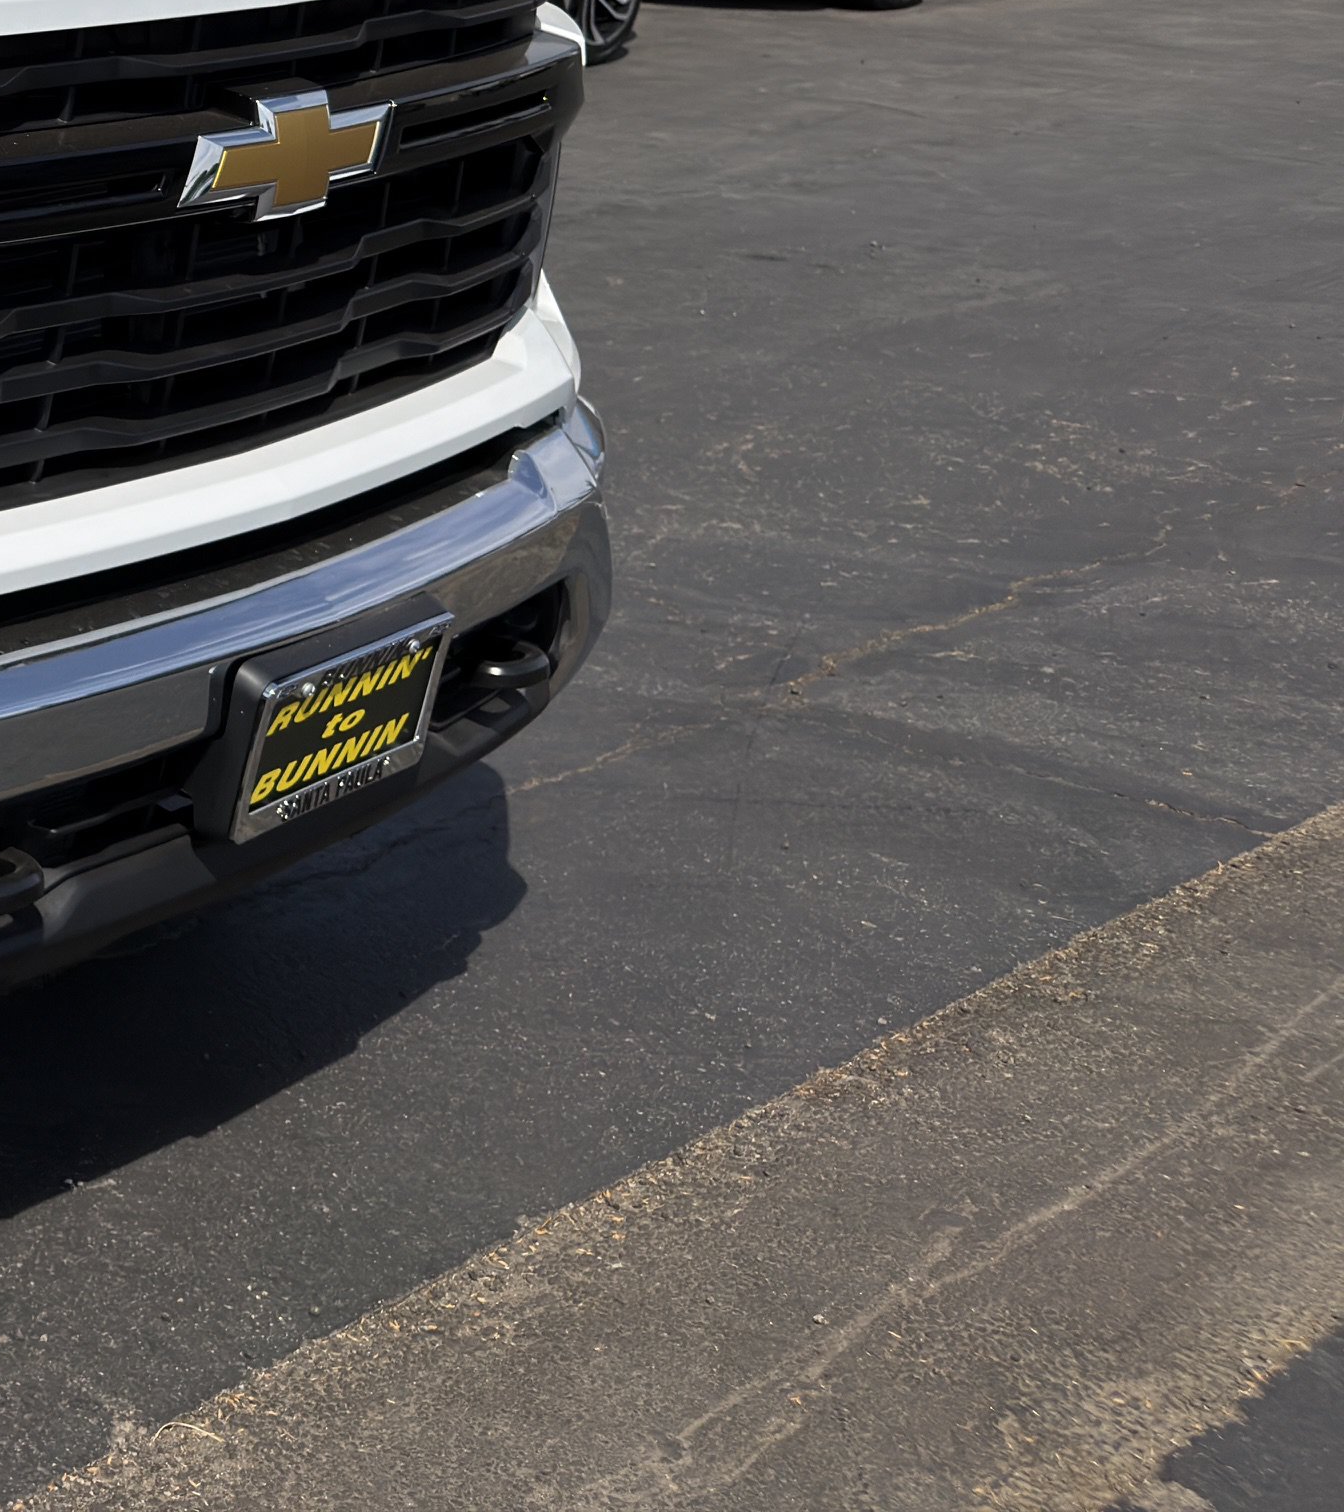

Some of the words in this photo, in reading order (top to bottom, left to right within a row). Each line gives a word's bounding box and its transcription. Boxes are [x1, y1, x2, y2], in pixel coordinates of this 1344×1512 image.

[265, 645, 434, 737] RUNNIN'
[321, 708, 366, 739] to
[249, 712, 410, 805] BUNNIN
[335, 756, 385, 797] PAULA
